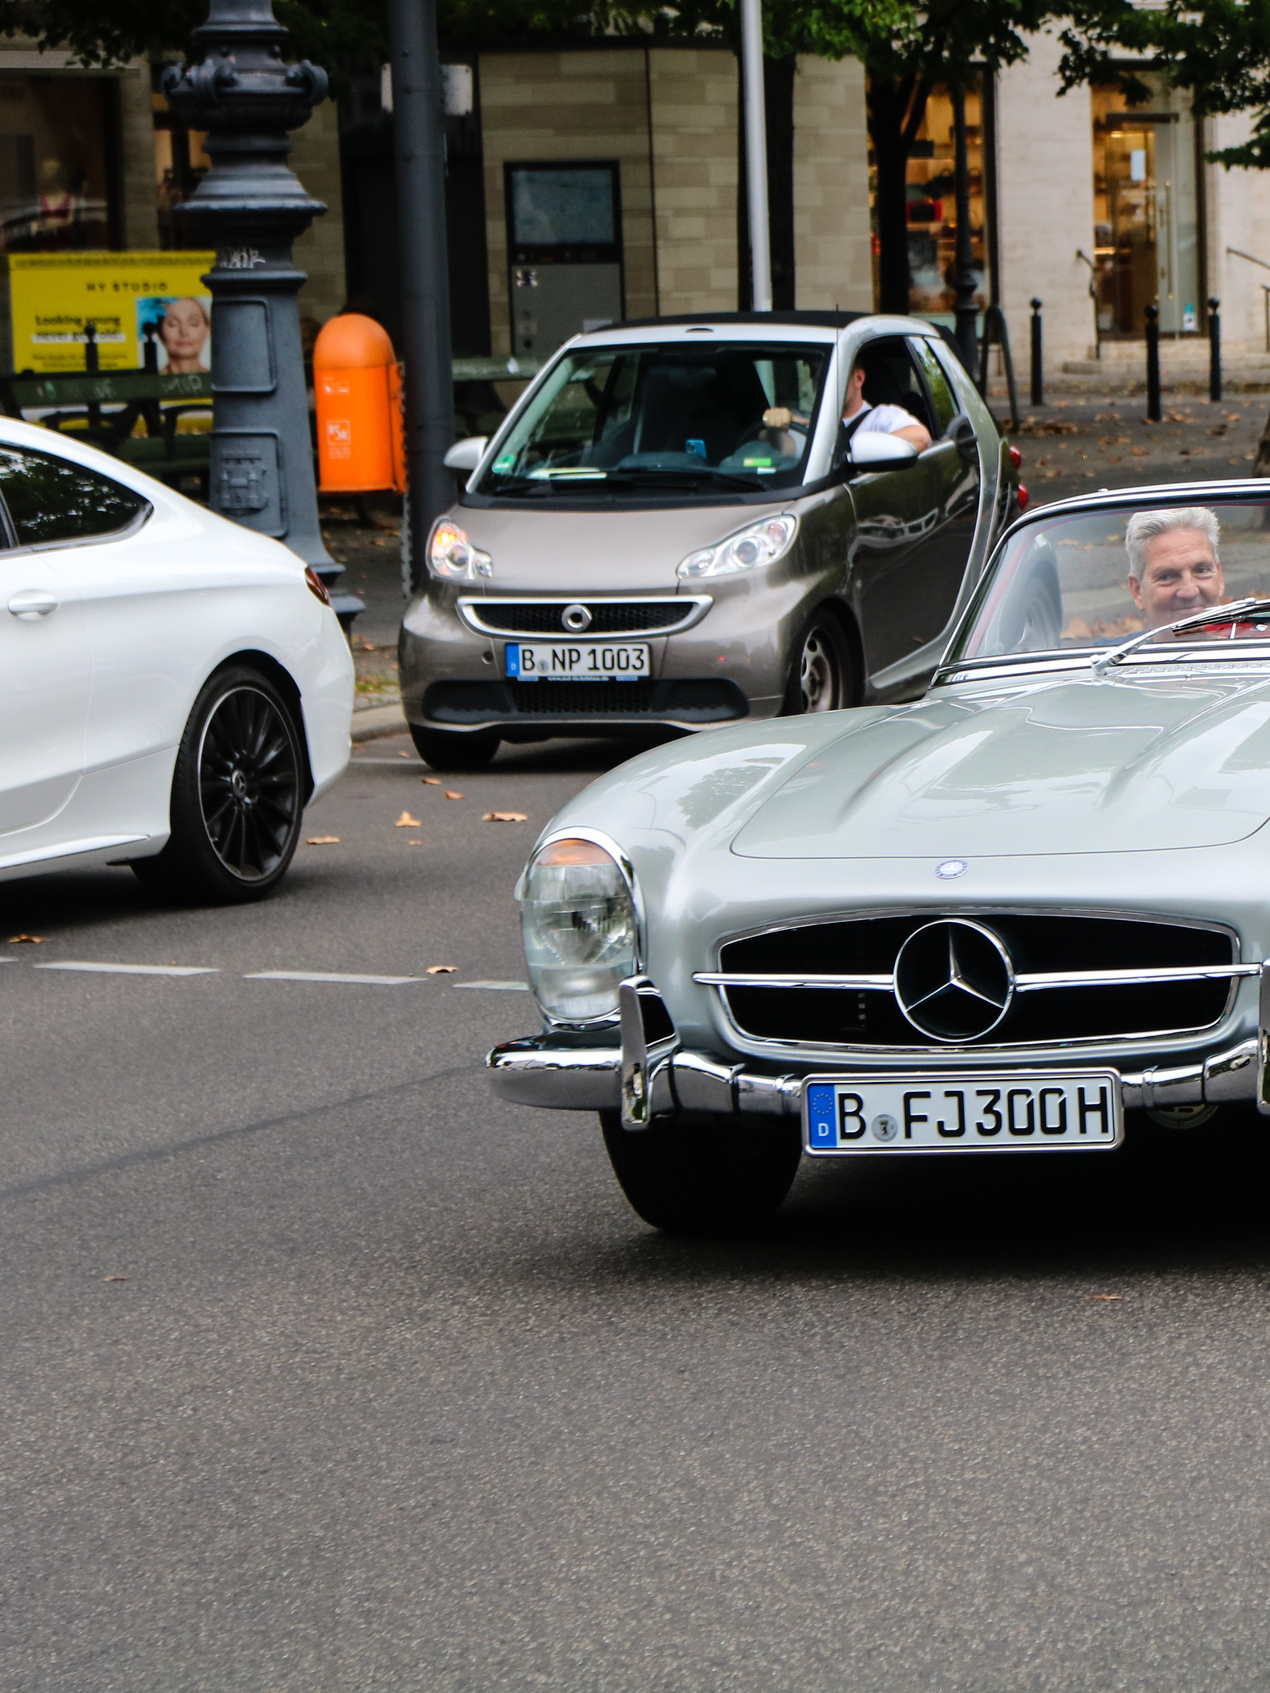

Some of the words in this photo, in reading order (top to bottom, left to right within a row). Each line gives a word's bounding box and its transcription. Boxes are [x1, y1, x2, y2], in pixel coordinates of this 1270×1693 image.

[112, 281, 168, 293] STUDIO
[35, 315, 82, 328] Looking
[510, 663, 517, 671] D
[521, 648, 536, 672] B
[552, 648, 581, 671] NP
[587, 648, 645, 671] 1003
[818, 1123, 830, 1138] D
[837, 1092, 867, 1140] B
